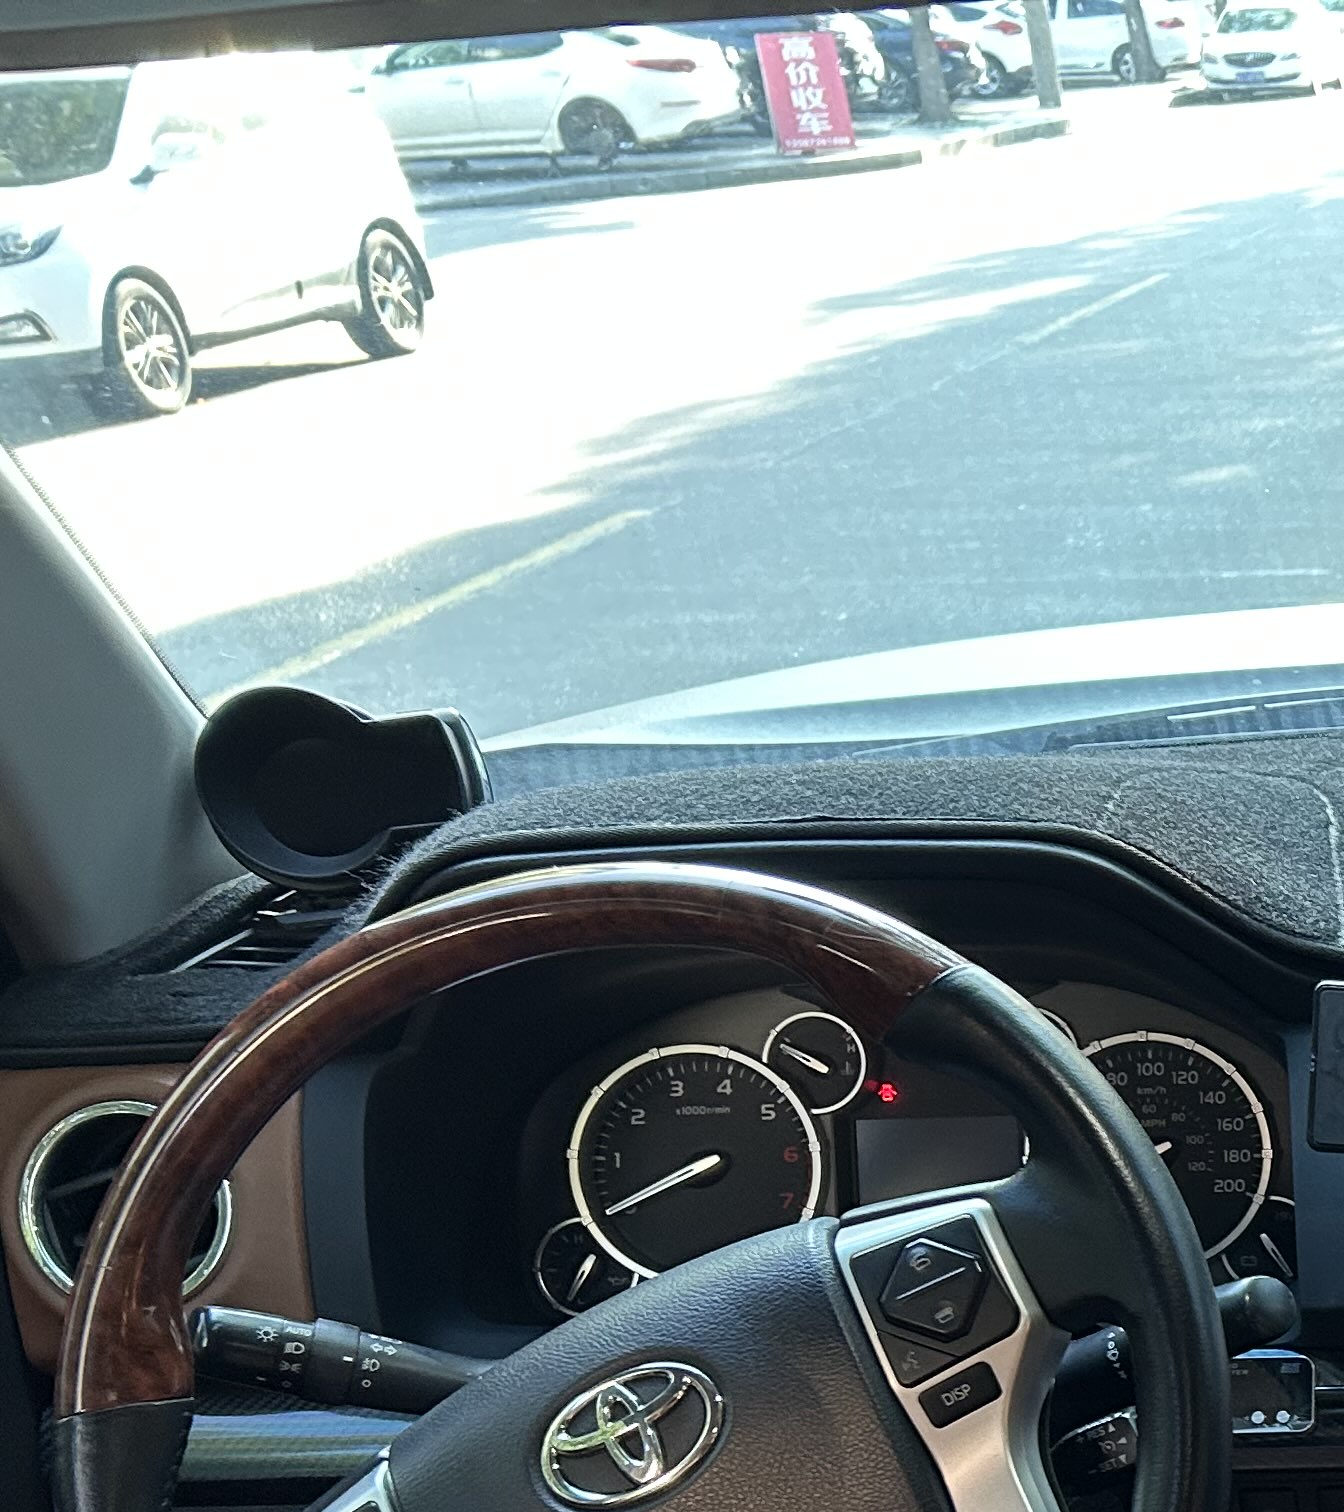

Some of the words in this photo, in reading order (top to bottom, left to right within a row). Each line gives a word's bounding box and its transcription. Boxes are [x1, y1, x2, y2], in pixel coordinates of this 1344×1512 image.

[779, 36, 834, 136] 高价收车
[1136, 1062, 1165, 1077] 100
[716, 1078, 733, 1096] 4
[1171, 1071, 1199, 1086] 120
[669, 1080, 685, 1098] 3
[1199, 1090, 1227, 1105] 140
[630, 1108, 646, 1126] 2
[761, 1103, 777, 1121] 5
[1216, 1117, 1245, 1132] 160
[614, 1151, 621, 1169] 1
[783, 1146, 799, 1163] 6
[1223, 1149, 1251, 1164] 180
[1213, 1179, 1246, 1193] 200
[780, 1192, 795, 1209] 7
[284, 1325, 314, 1338] AUTO
[941, 1383, 972, 1407] DISP
